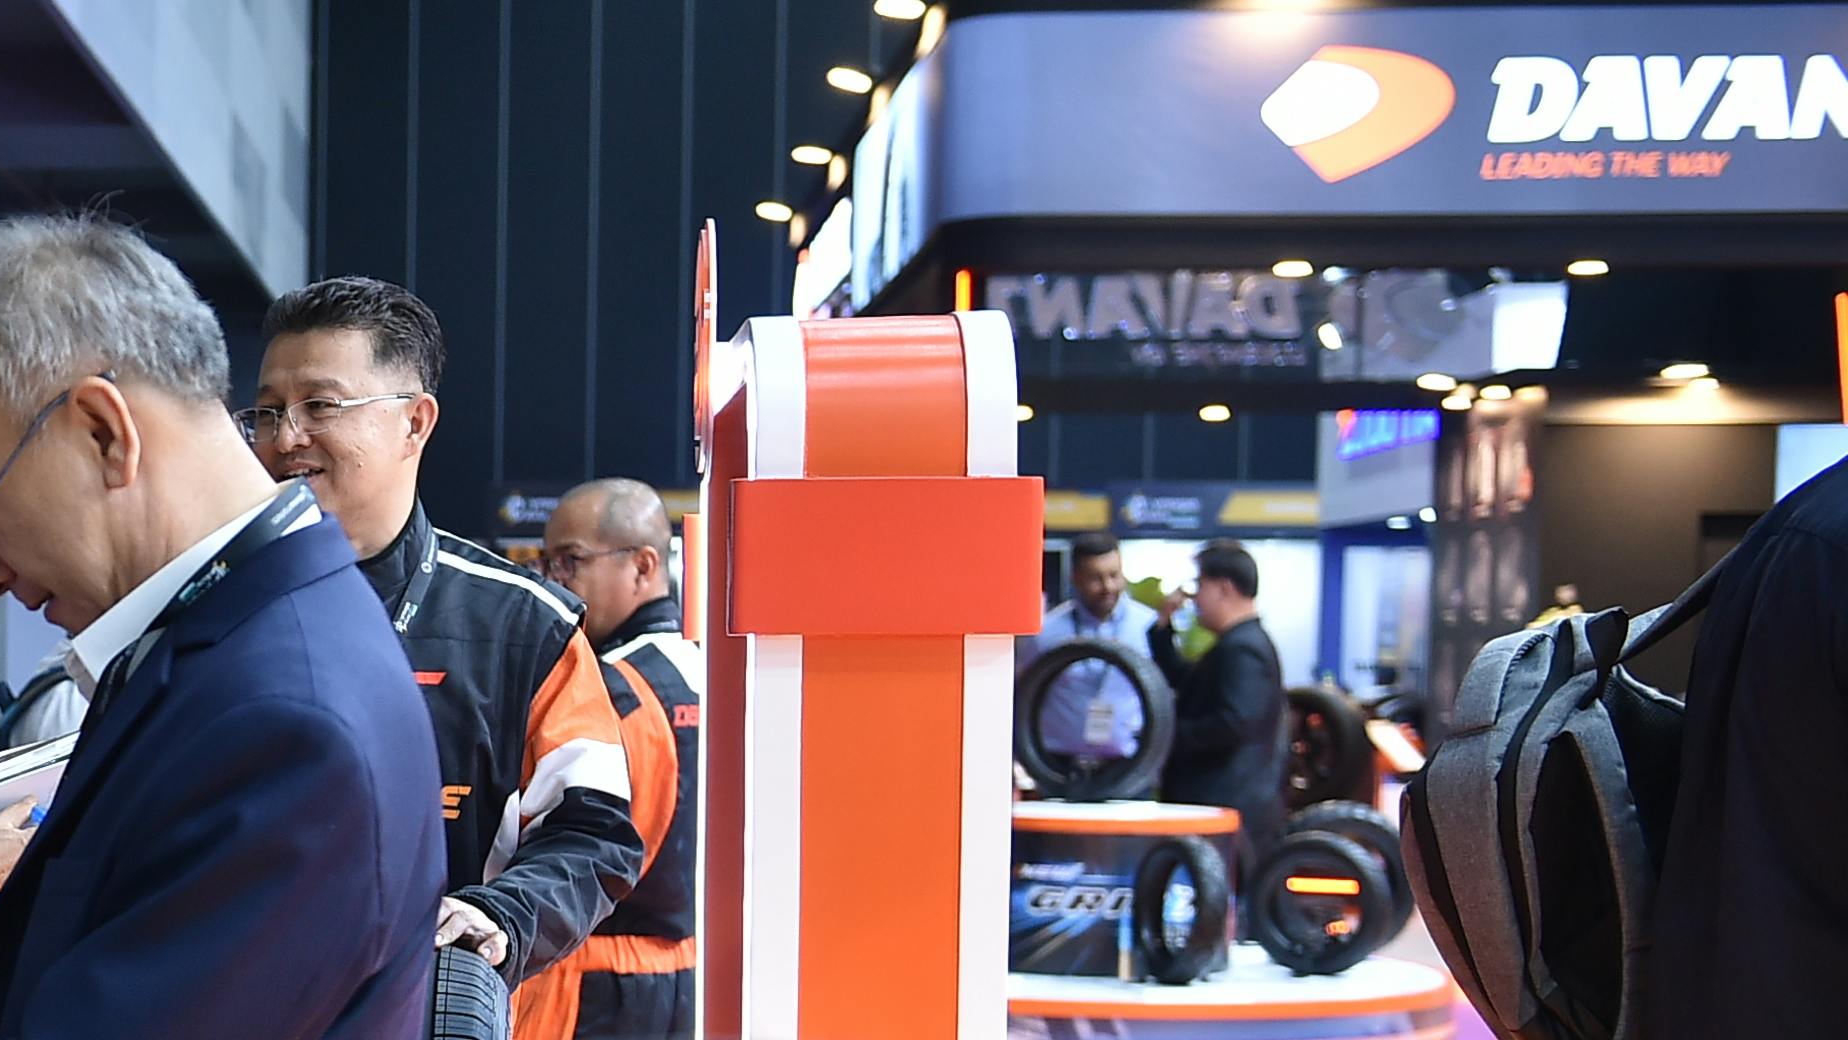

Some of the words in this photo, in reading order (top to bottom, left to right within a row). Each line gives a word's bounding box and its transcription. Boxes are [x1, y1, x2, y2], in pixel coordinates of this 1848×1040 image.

[1480, 151, 1605, 181] LEADING
[1609, 151, 1664, 178] THE
[1666, 151, 1732, 178] WAY
